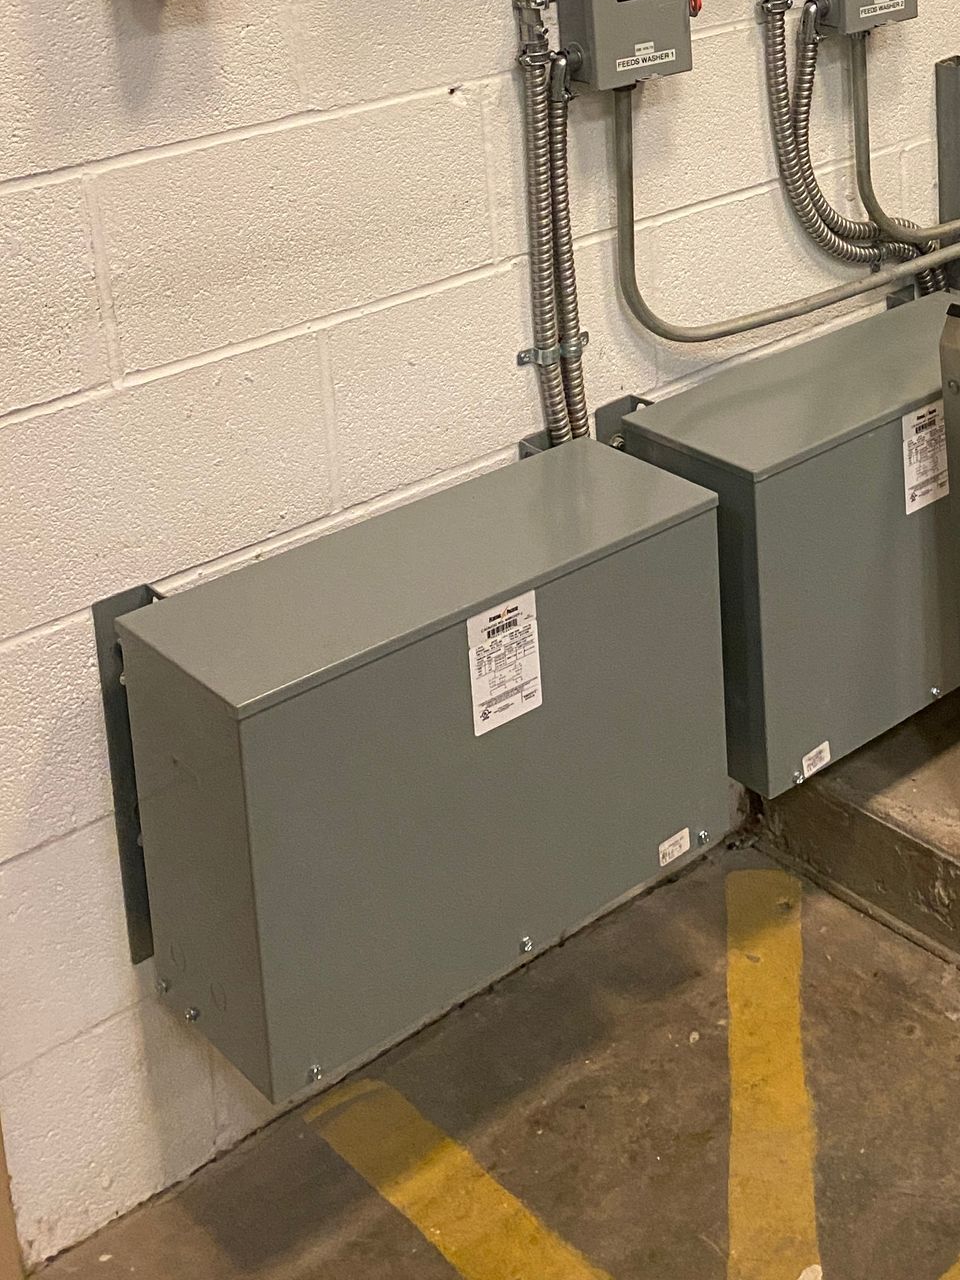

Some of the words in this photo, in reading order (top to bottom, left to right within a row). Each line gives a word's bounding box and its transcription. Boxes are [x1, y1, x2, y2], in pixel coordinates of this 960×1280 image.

[860, 6, 878, 15] FEEDS
[878, 1, 900, 11] WASHER
[617, 58, 640, 68] FEEDS
[640, 52, 669, 64] WASHER
